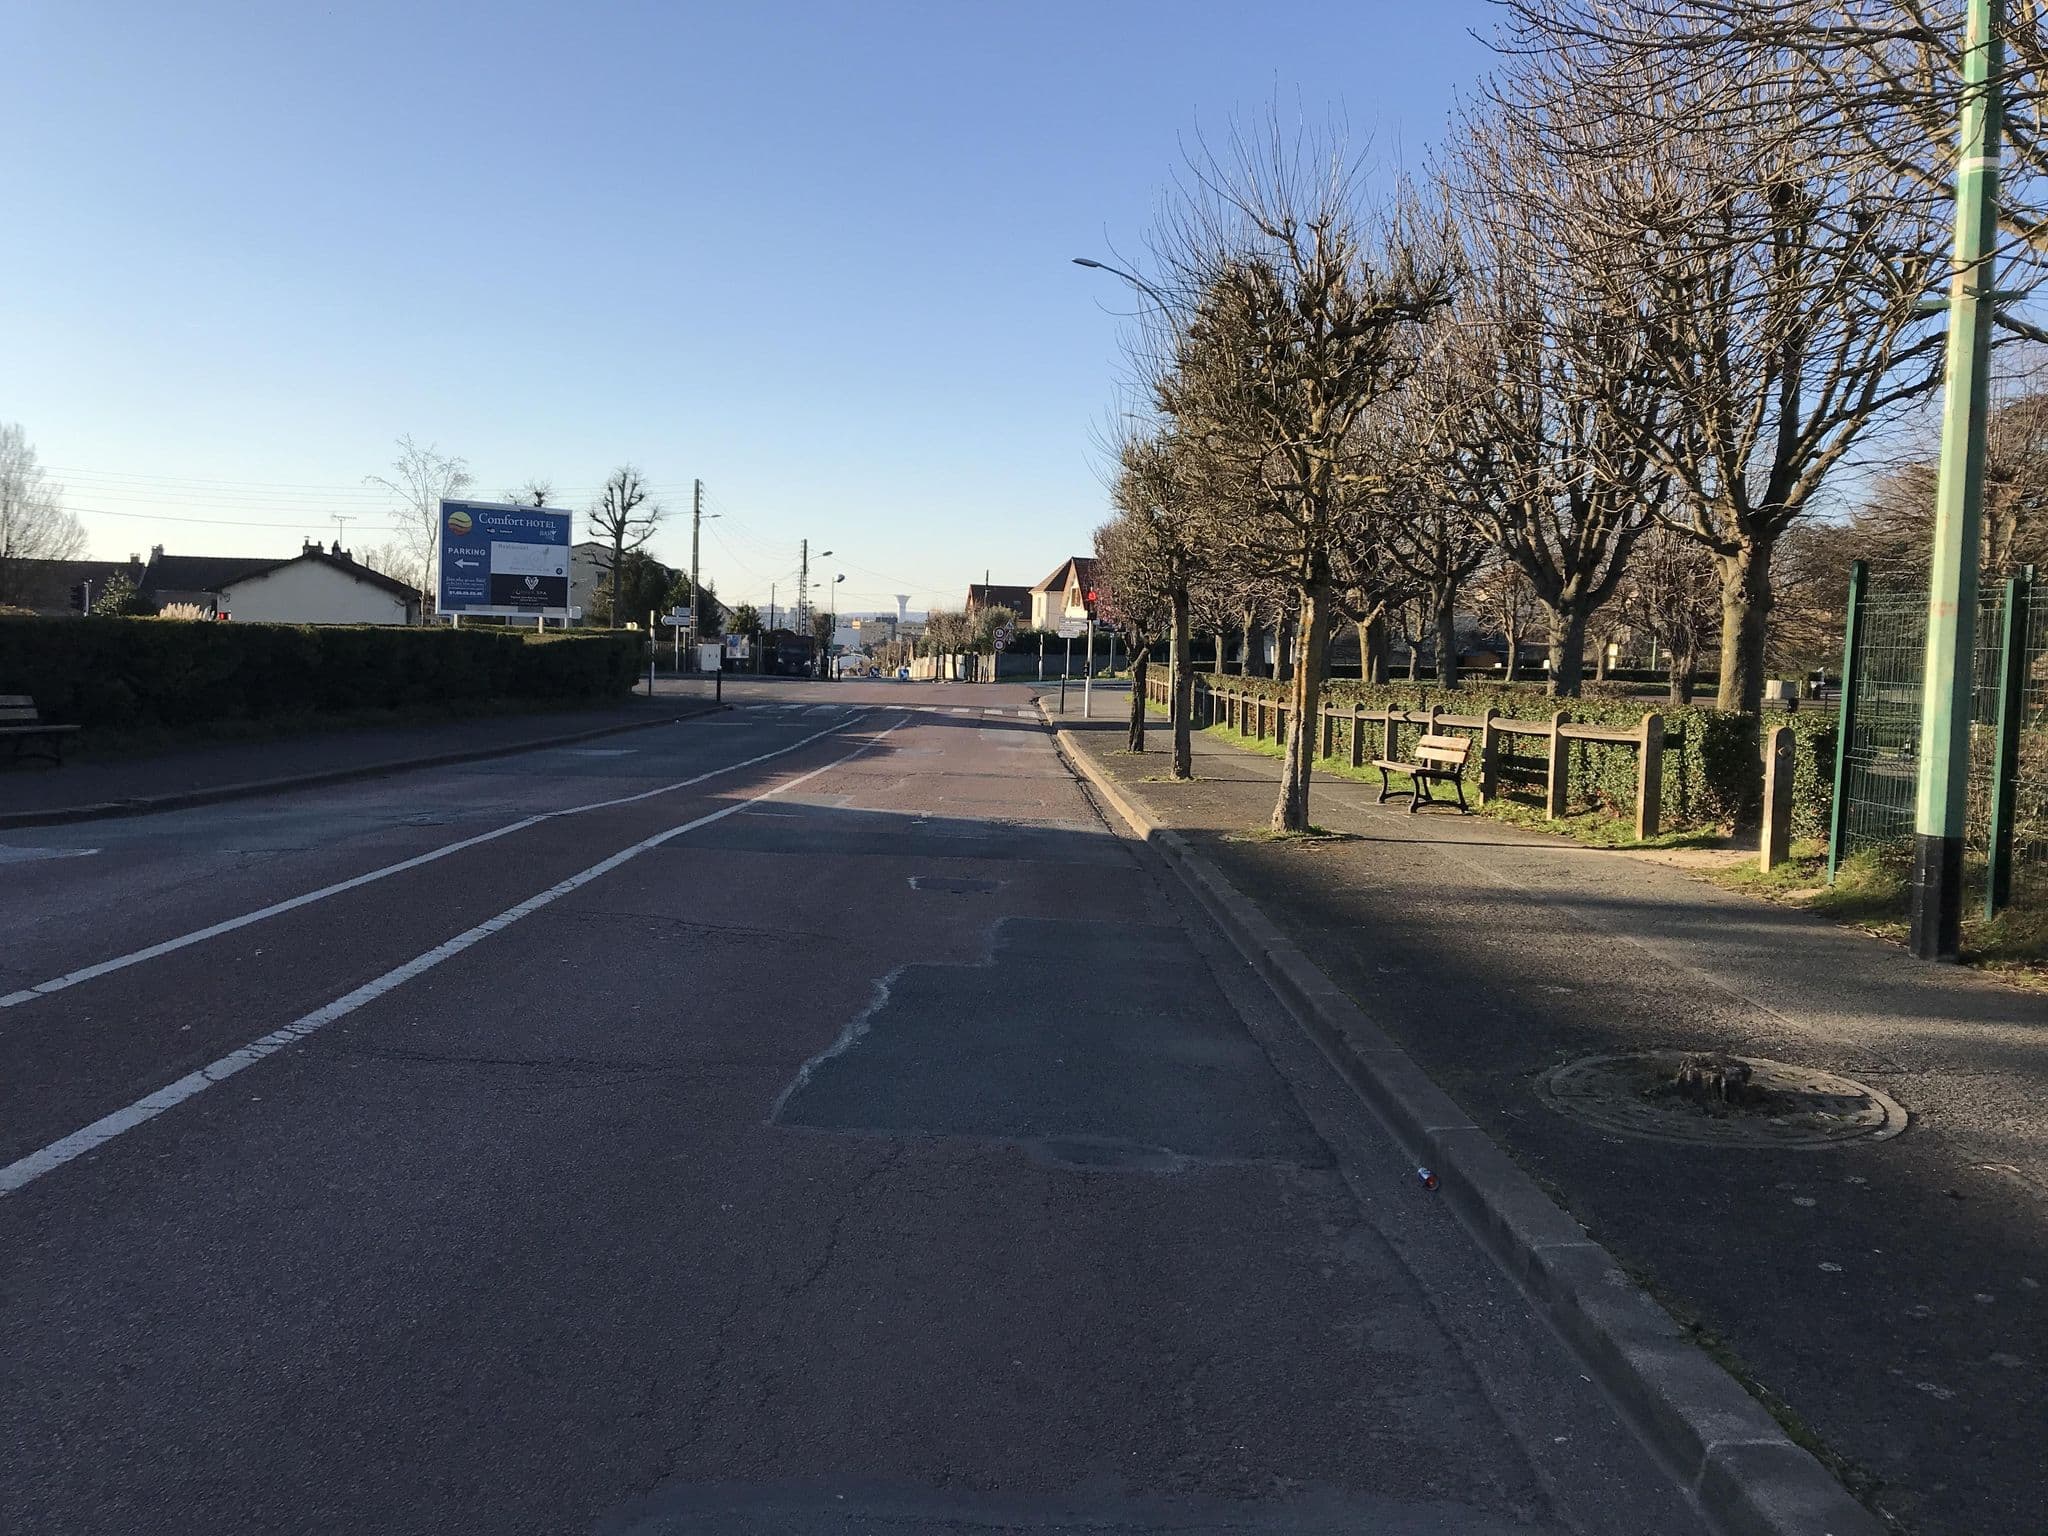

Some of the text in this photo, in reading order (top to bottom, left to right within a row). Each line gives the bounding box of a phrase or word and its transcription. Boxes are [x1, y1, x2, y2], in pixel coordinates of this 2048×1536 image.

[478, 512, 557, 529] Comfort HOTEL
[447, 547, 486, 556] PARKING
